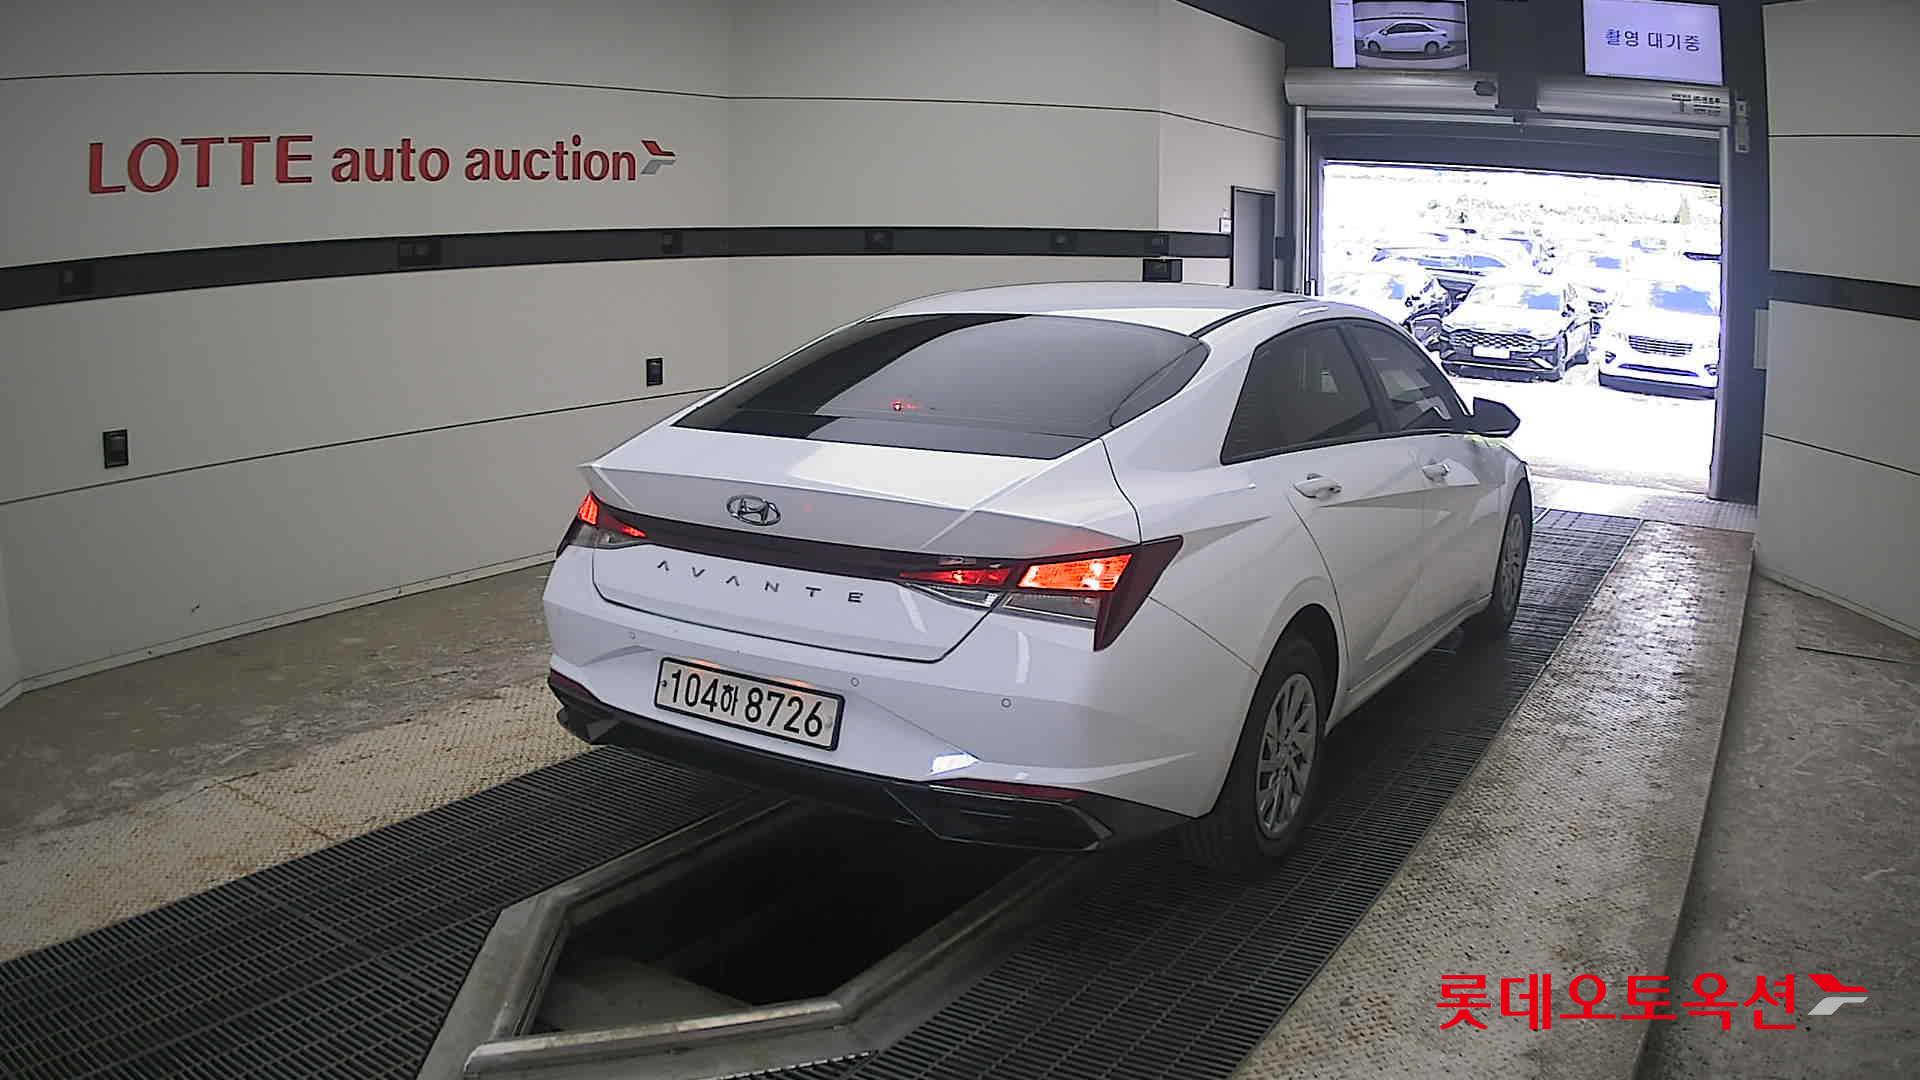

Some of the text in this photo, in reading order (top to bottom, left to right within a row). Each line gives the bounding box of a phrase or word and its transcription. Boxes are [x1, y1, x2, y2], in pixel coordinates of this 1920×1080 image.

[1647, 31, 1701, 52] 대기중
[89, 134, 636, 194] LOTTE auto auction
[657, 560, 864, 603] AVANTE
[672, 669, 823, 738] 104하 8726
